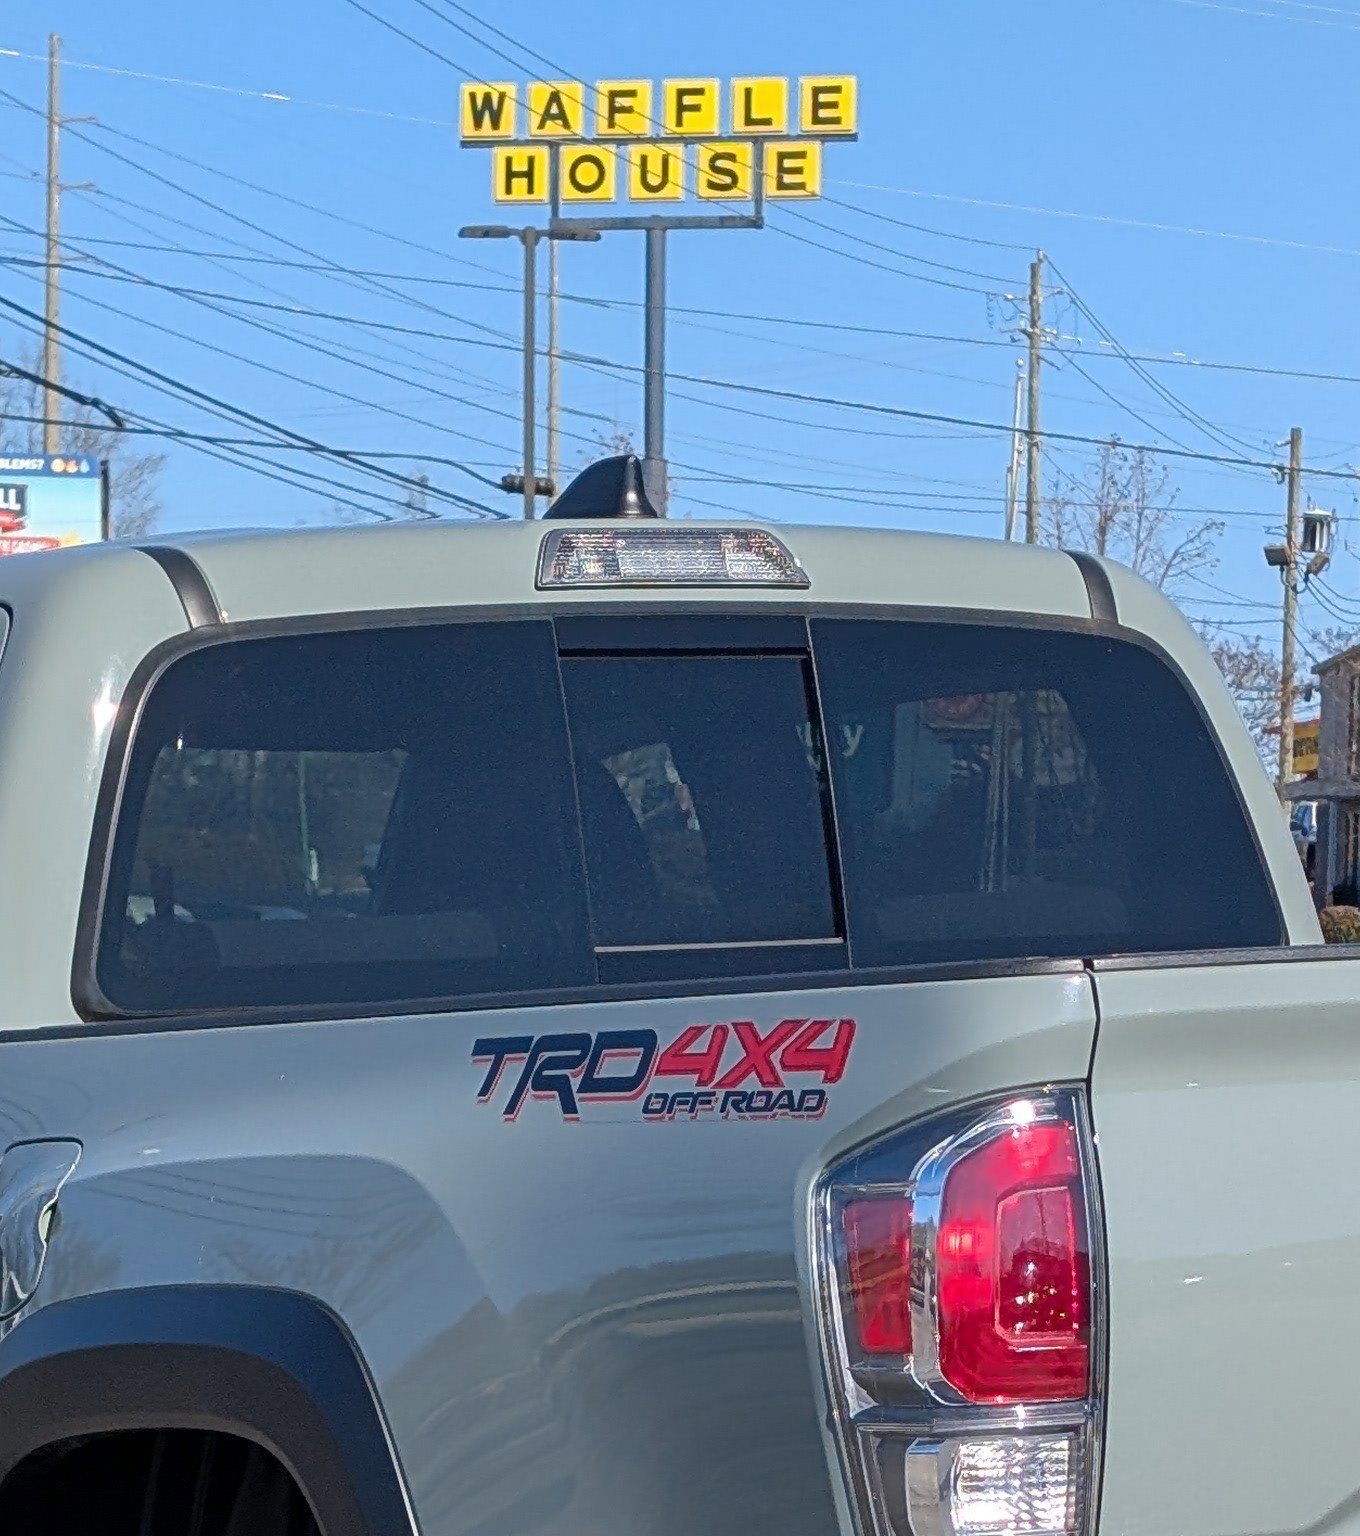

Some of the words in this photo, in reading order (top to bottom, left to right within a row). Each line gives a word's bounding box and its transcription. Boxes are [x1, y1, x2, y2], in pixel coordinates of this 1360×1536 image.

[469, 85, 843, 132] WAFFLE
[504, 150, 808, 196] HOUSE
[471, 1028, 660, 1122] TRD
[641, 1091, 718, 1120] OFF
[719, 1088, 832, 1120] ROAD
